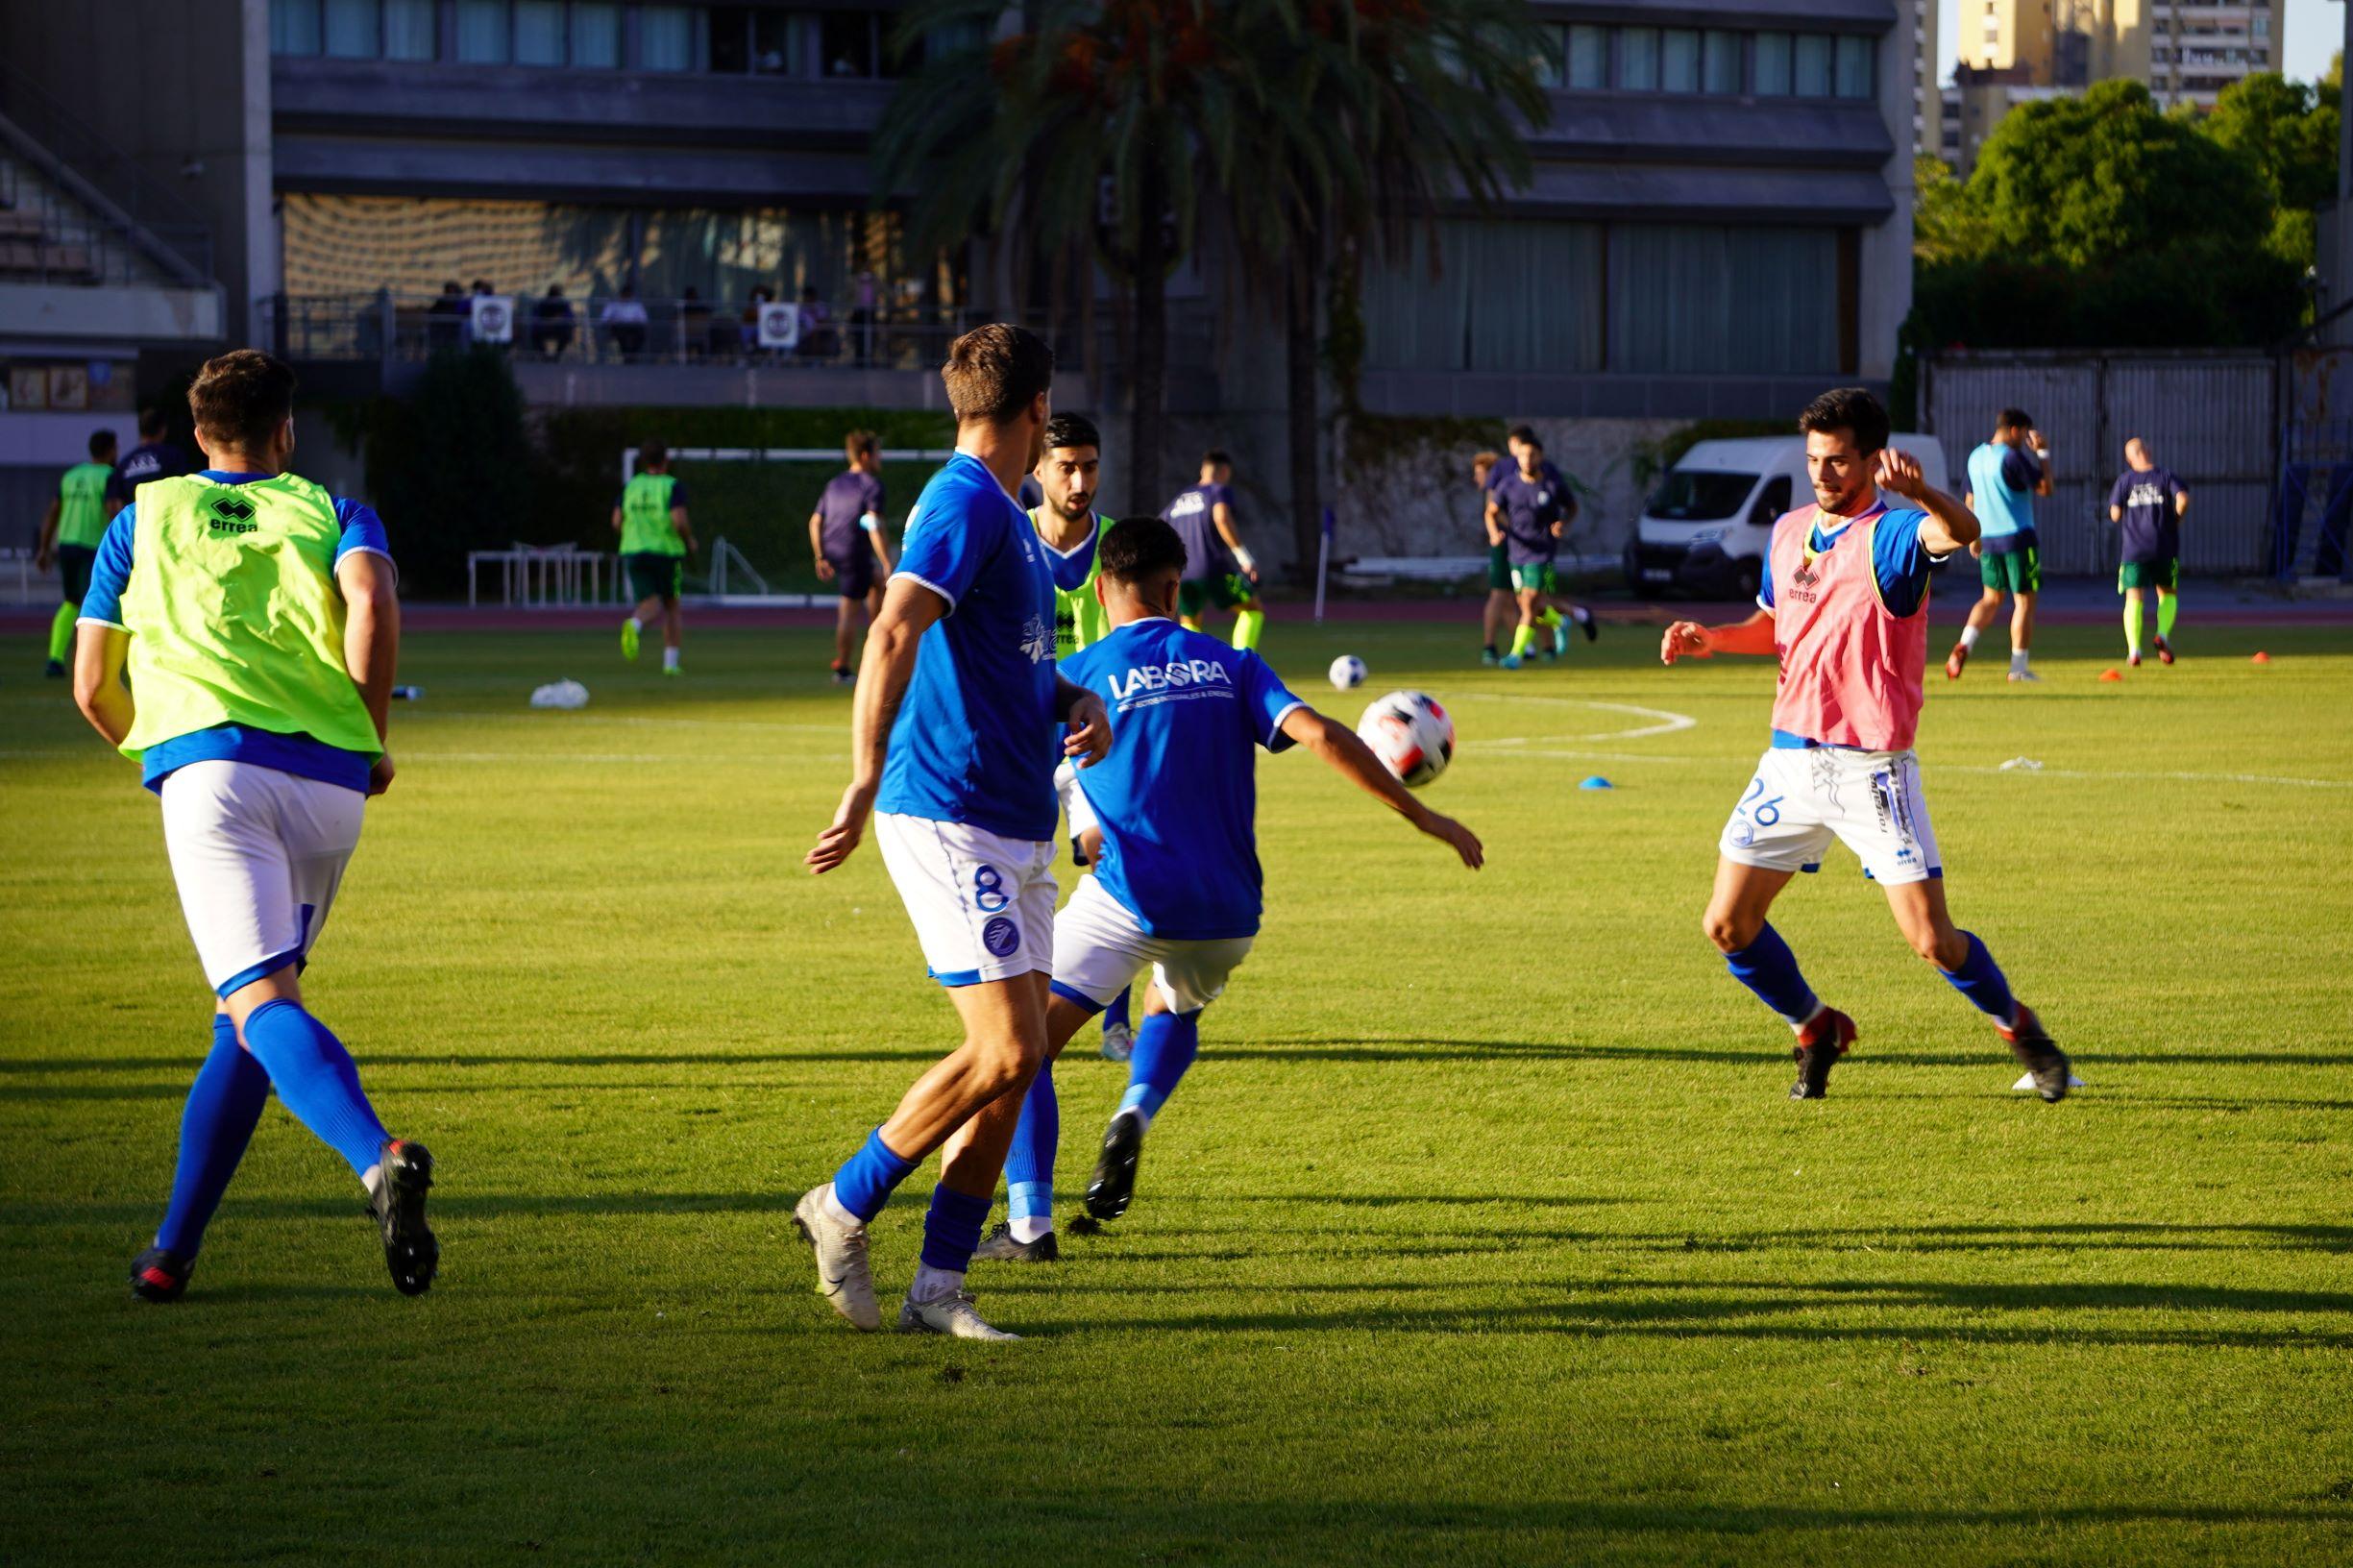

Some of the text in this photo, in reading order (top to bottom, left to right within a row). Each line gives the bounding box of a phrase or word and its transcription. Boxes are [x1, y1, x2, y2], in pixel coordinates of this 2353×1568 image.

[210, 519, 257, 533] errea
[1789, 588, 1817, 603] errea
[1056, 634, 1080, 645] rrea
[1108, 660, 1232, 699] LABORA
[1737, 777, 1784, 826] 26
[975, 865, 1009, 913] 8
